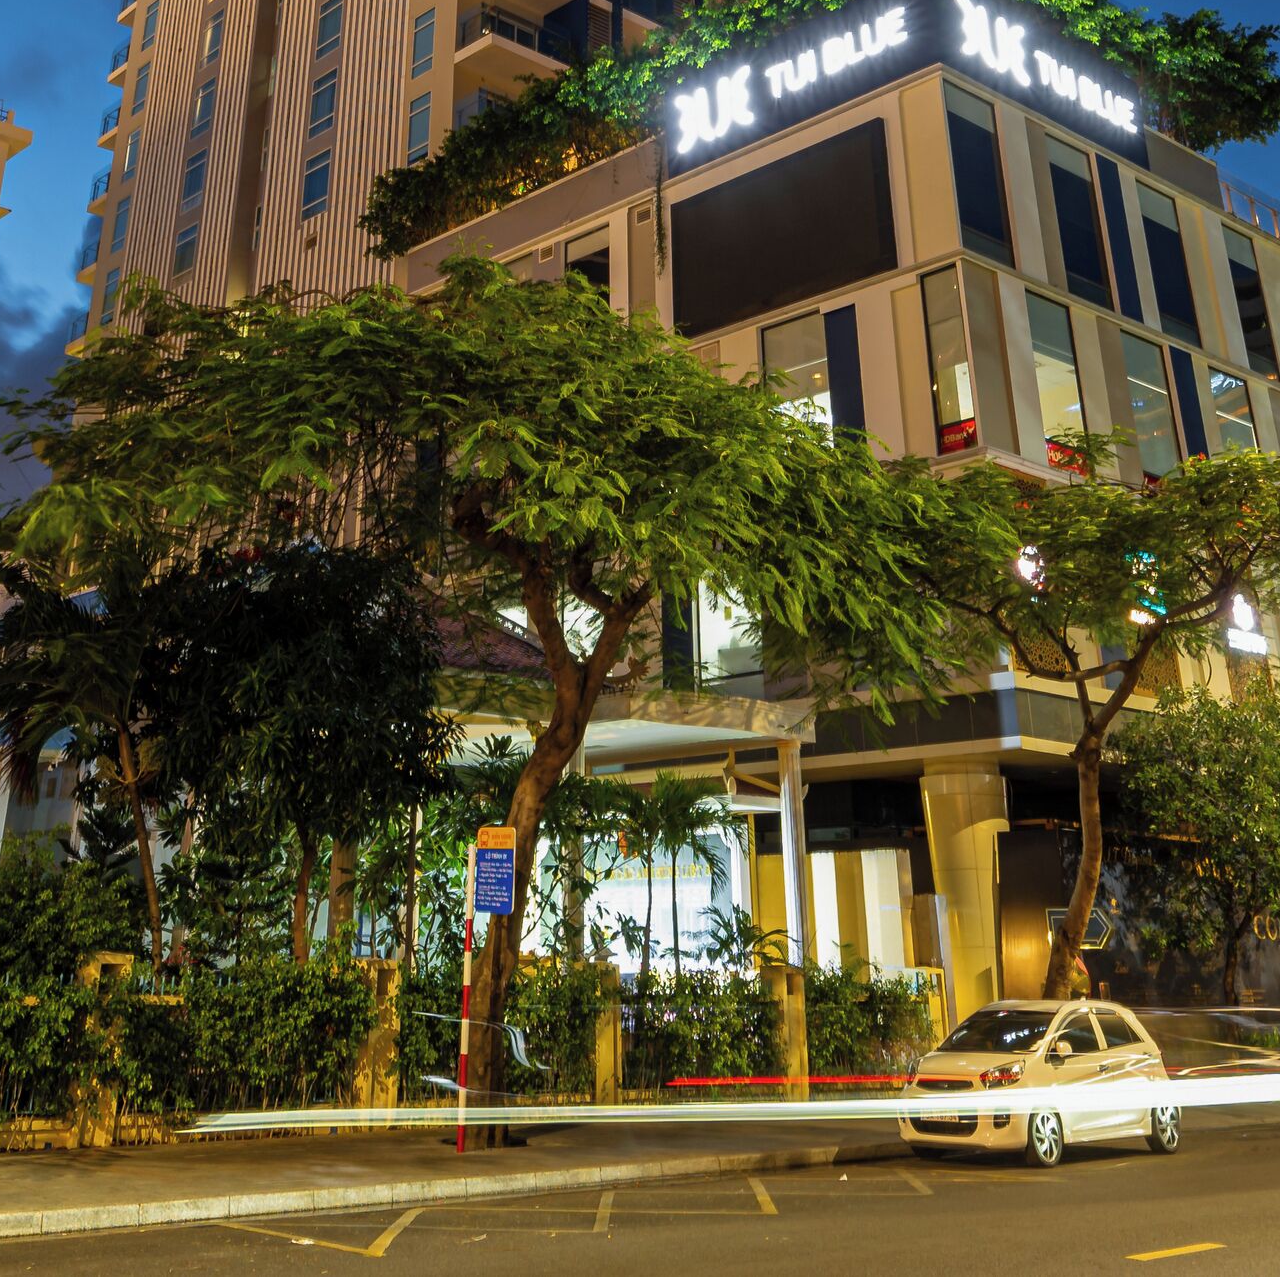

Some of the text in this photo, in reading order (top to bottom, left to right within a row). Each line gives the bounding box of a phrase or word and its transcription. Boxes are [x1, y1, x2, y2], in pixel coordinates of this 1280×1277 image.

[765, 49, 817, 98] TUI
[821, 6, 908, 75] BLUE
[1033, 49, 1138, 134] TUI BLUE
